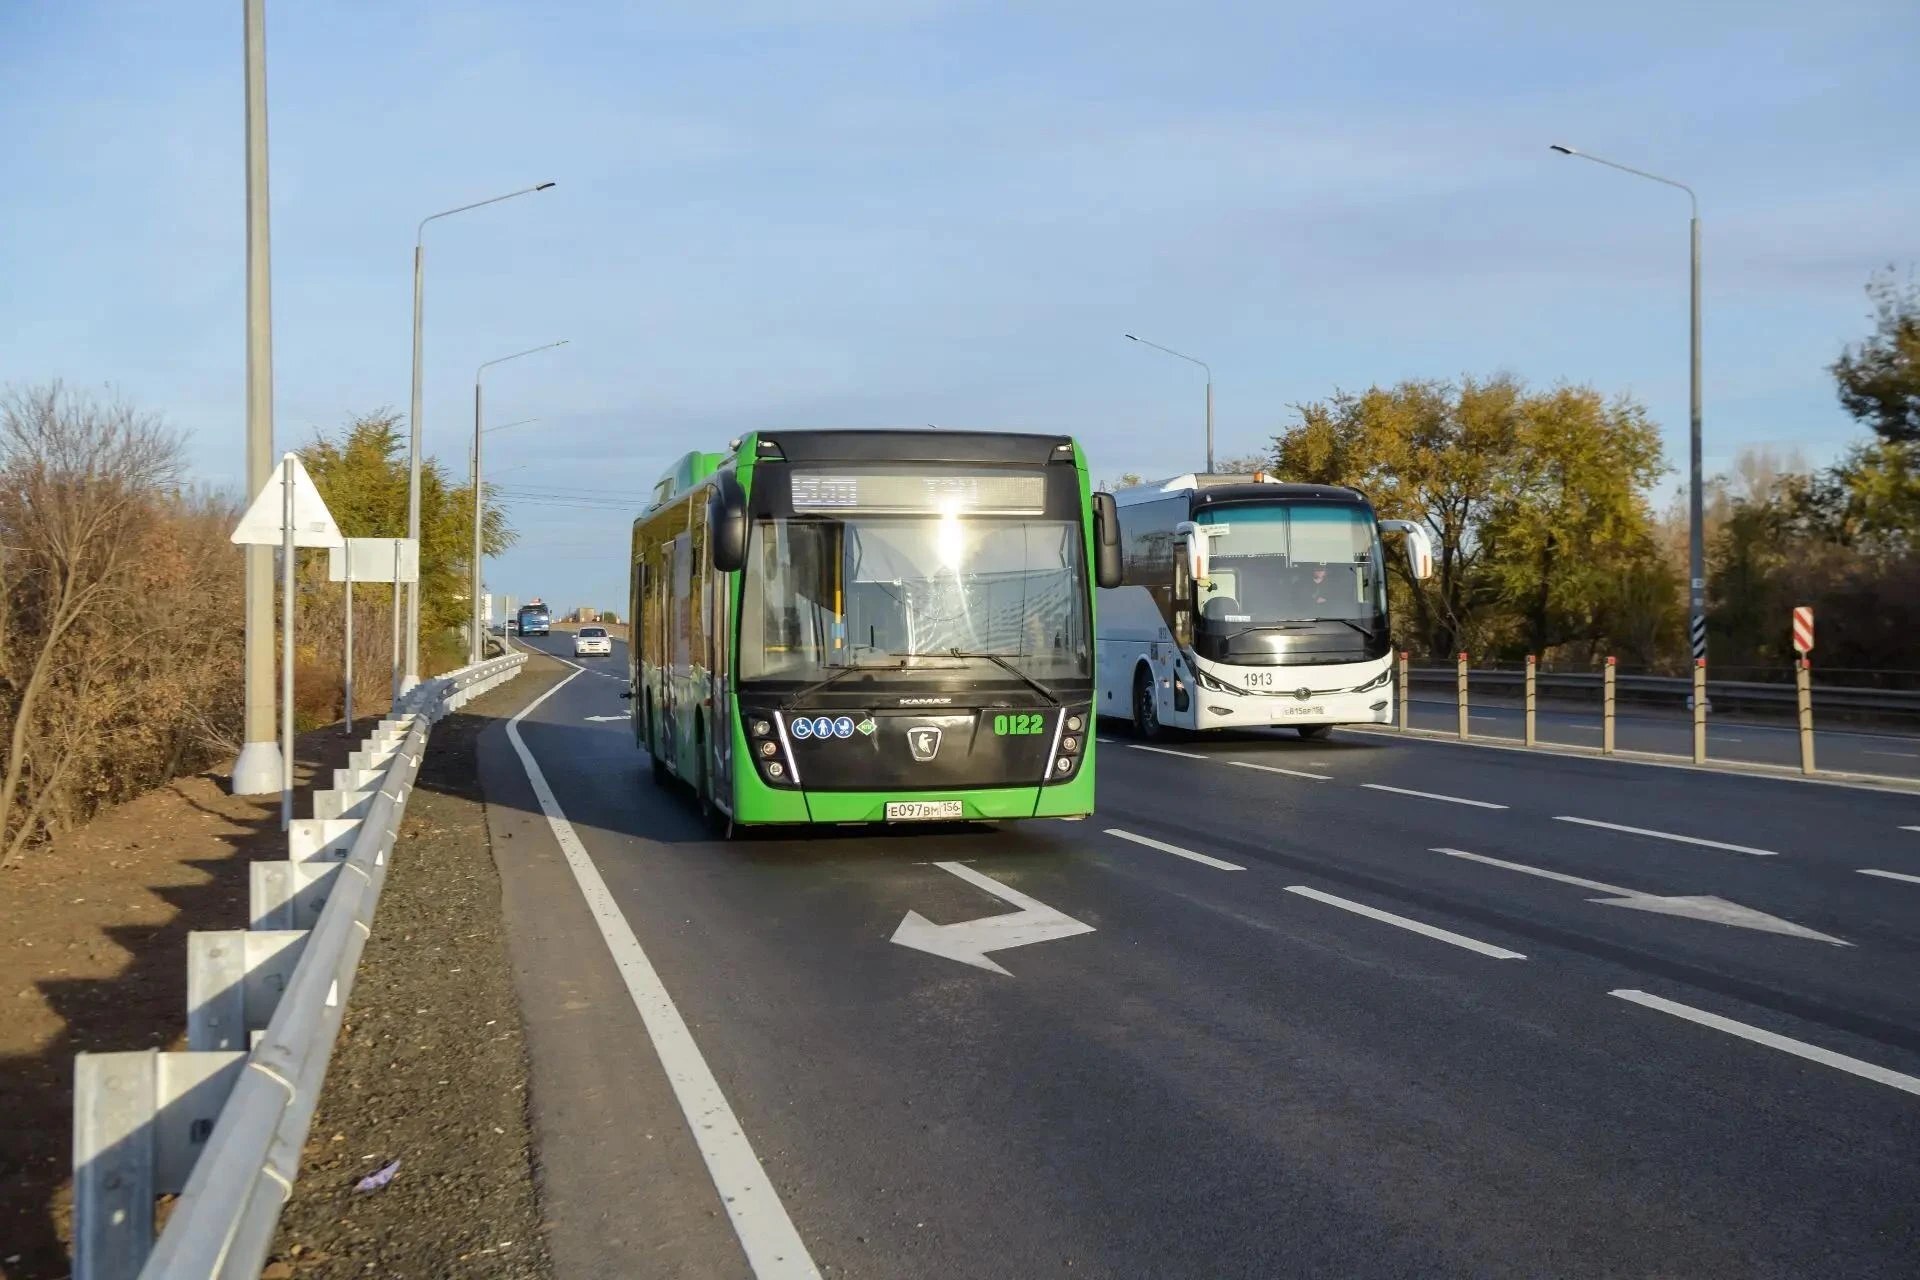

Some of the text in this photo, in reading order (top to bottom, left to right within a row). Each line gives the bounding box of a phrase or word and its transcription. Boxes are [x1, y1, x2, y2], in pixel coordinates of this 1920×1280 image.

[1243, 672, 1272, 686] 1913
[994, 714, 1043, 736] 0122
[890, 802, 960, 817] Е097ВМ 156
